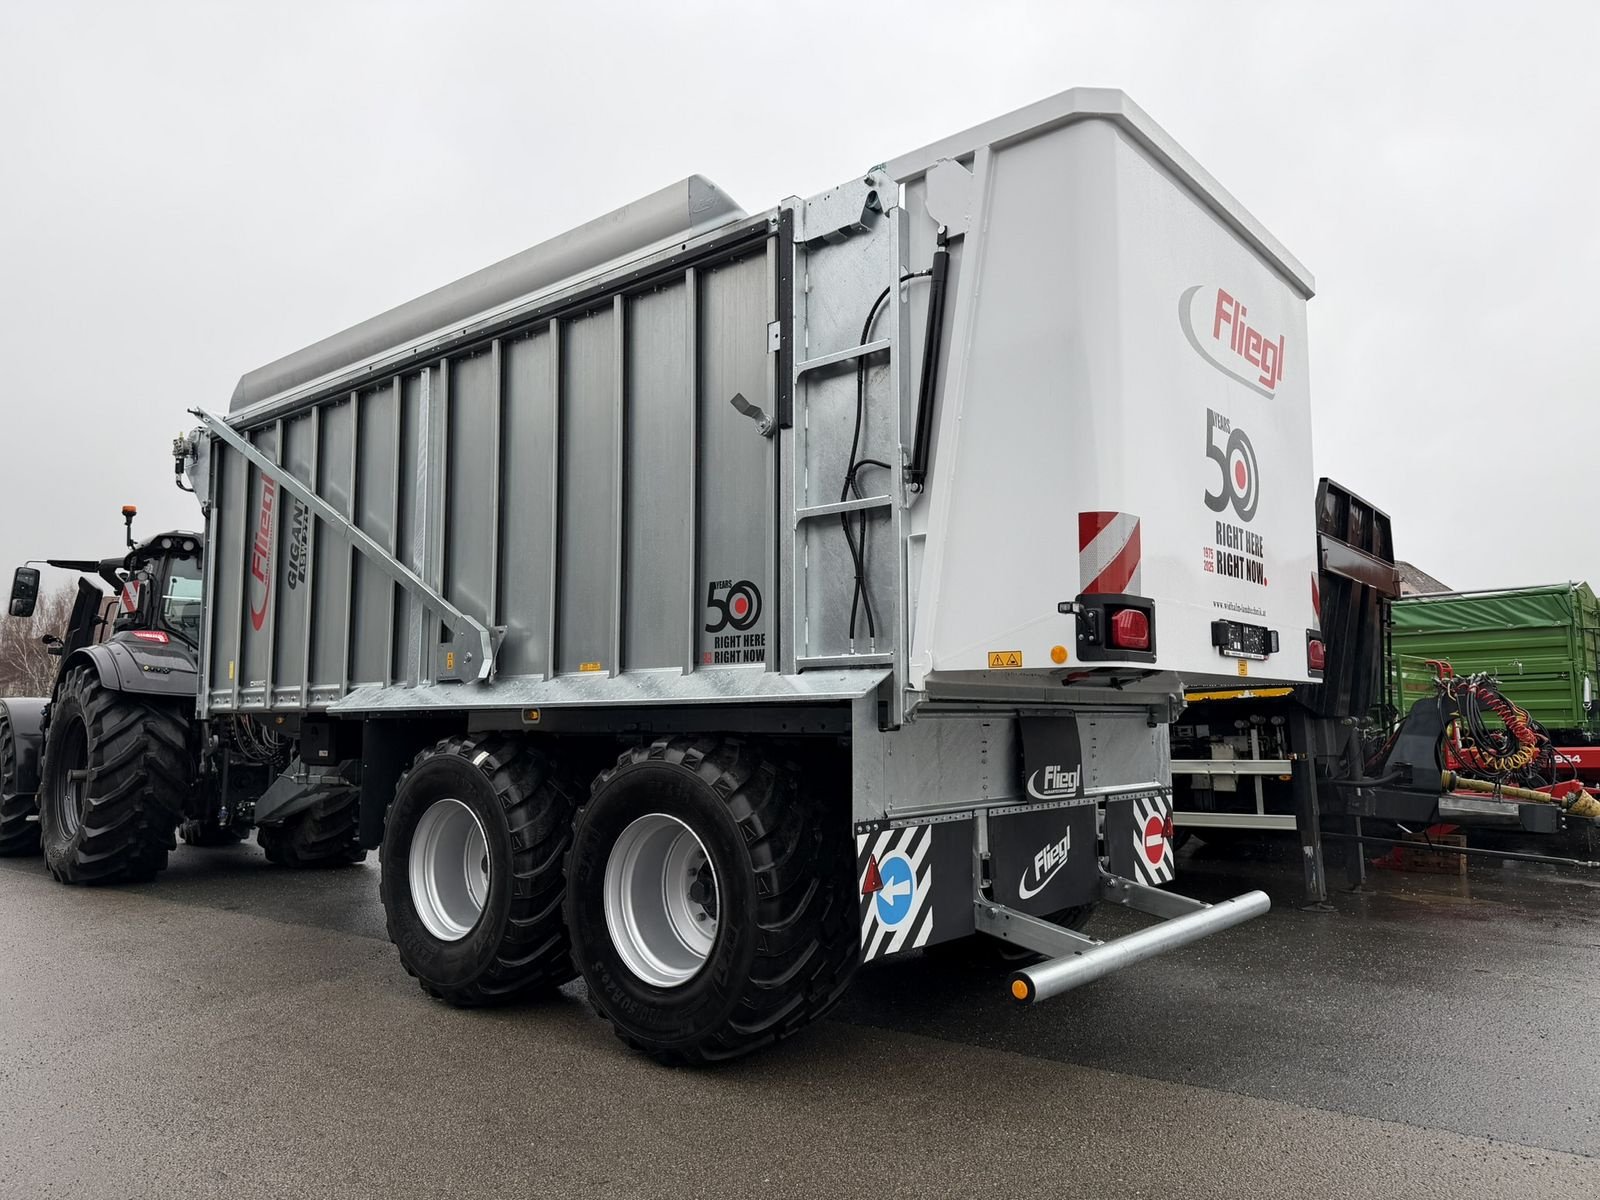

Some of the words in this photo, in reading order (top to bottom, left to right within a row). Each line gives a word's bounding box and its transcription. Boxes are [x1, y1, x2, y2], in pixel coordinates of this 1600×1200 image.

[1213, 287, 1285, 390] Fliegl
[1213, 410, 1231, 434] YEARS
[1204, 407, 1259, 523] 50
[1203, 546, 1214, 560] 1975
[1216, 520, 1244, 550] RIGHT
[1245, 530, 1264, 558] HERE
[1203, 560, 1214, 573] 2025
[1216, 550, 1244, 579] RIGHT
[715, 579, 732, 590] YEARS
[705, 580, 762, 633] 50
[714, 635, 741, 649] RIGHT
[743, 633, 766, 647] HERE
[714, 650, 741, 664] RIGHT
[743, 648, 765, 662] NOW
[1044, 764, 1081, 793] Fliegl
[1034, 825, 1071, 882] Fliegl
